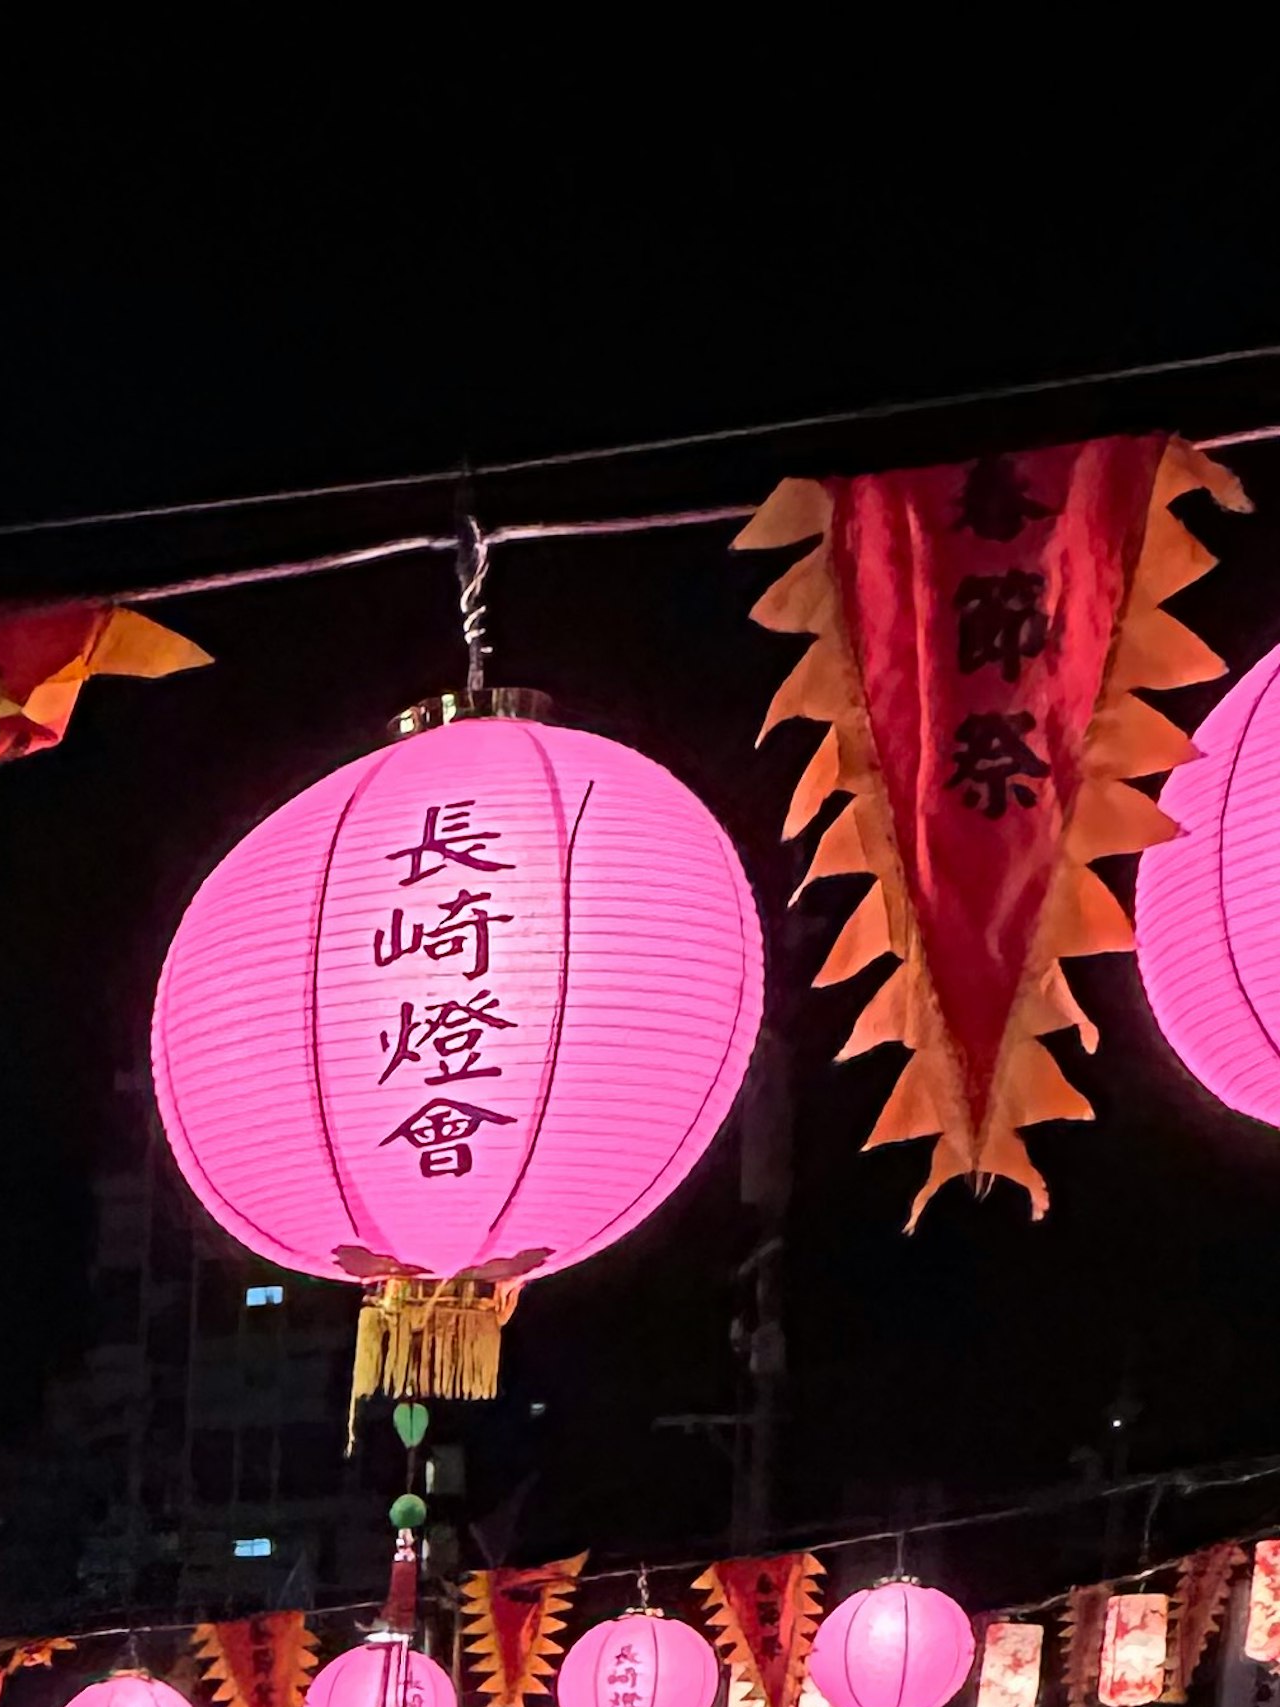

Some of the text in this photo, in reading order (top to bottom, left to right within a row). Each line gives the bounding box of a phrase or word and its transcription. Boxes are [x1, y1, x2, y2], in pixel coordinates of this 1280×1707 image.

[946, 452, 1065, 822] 春節祭
[373, 799, 519, 1180] 長崎燈會
